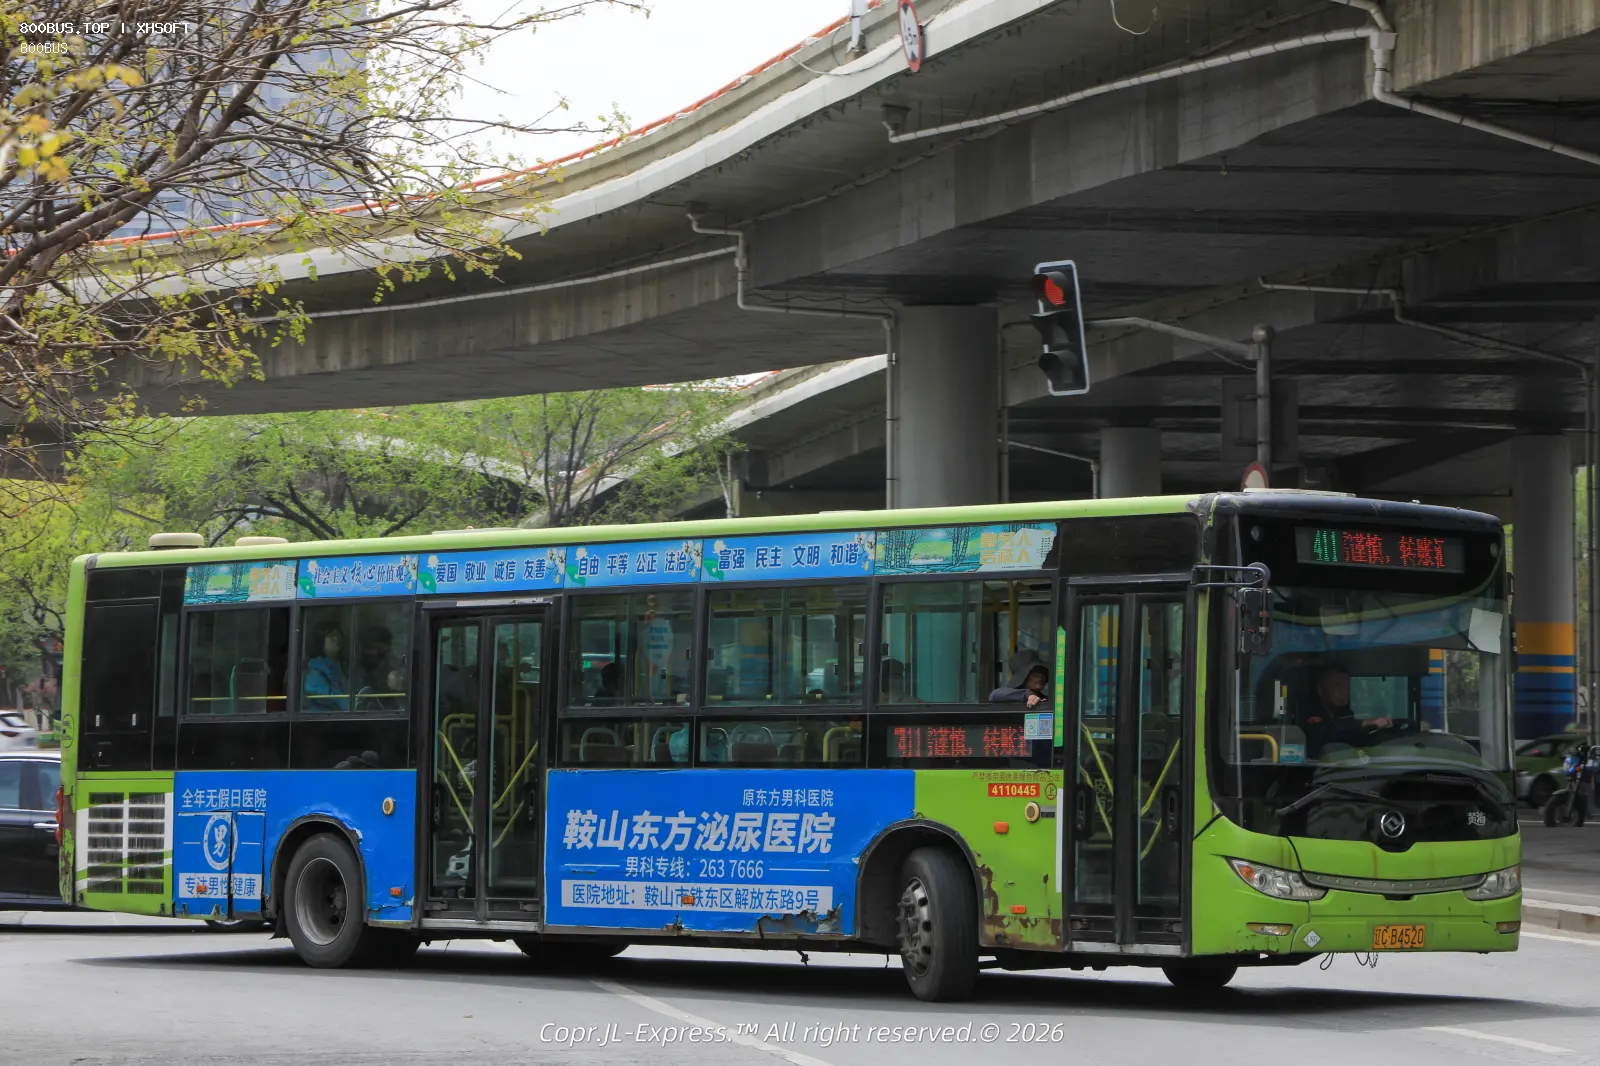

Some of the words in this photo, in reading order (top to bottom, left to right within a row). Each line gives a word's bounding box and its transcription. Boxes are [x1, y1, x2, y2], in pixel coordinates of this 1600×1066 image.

[718, 547, 746, 571] 富强
[755, 546, 783, 569] 民主
[792, 544, 821, 567] 文明
[830, 542, 860, 566] 和谐
[1313, 529, 1338, 562] 411
[313, 560, 405, 586] 社会主义核心价值观
[436, 563, 458, 583] 爱国
[464, 561, 487, 582] 敬业
[494, 560, 516, 581] 诚信
[523, 558, 546, 579] 友善
[578, 555, 600, 576] 自由
[606, 553, 629, 575] 平等
[635, 552, 659, 573] 公正
[664, 550, 687, 572] 法治
[182, 788, 267, 809] 全年无假日医院
[742, 788, 834, 807] 原东方男科医院
[991, 784, 1037, 796] 4110445
[1467, 811, 1486, 826] 黄海
[213, 825, 228, 858] 男
[562, 809, 836, 854] 鞍山东方泌尿医院
[625, 856, 691, 878] 男科专线：
[699, 859, 725, 878] 263
[729, 859, 764, 879] 7666
